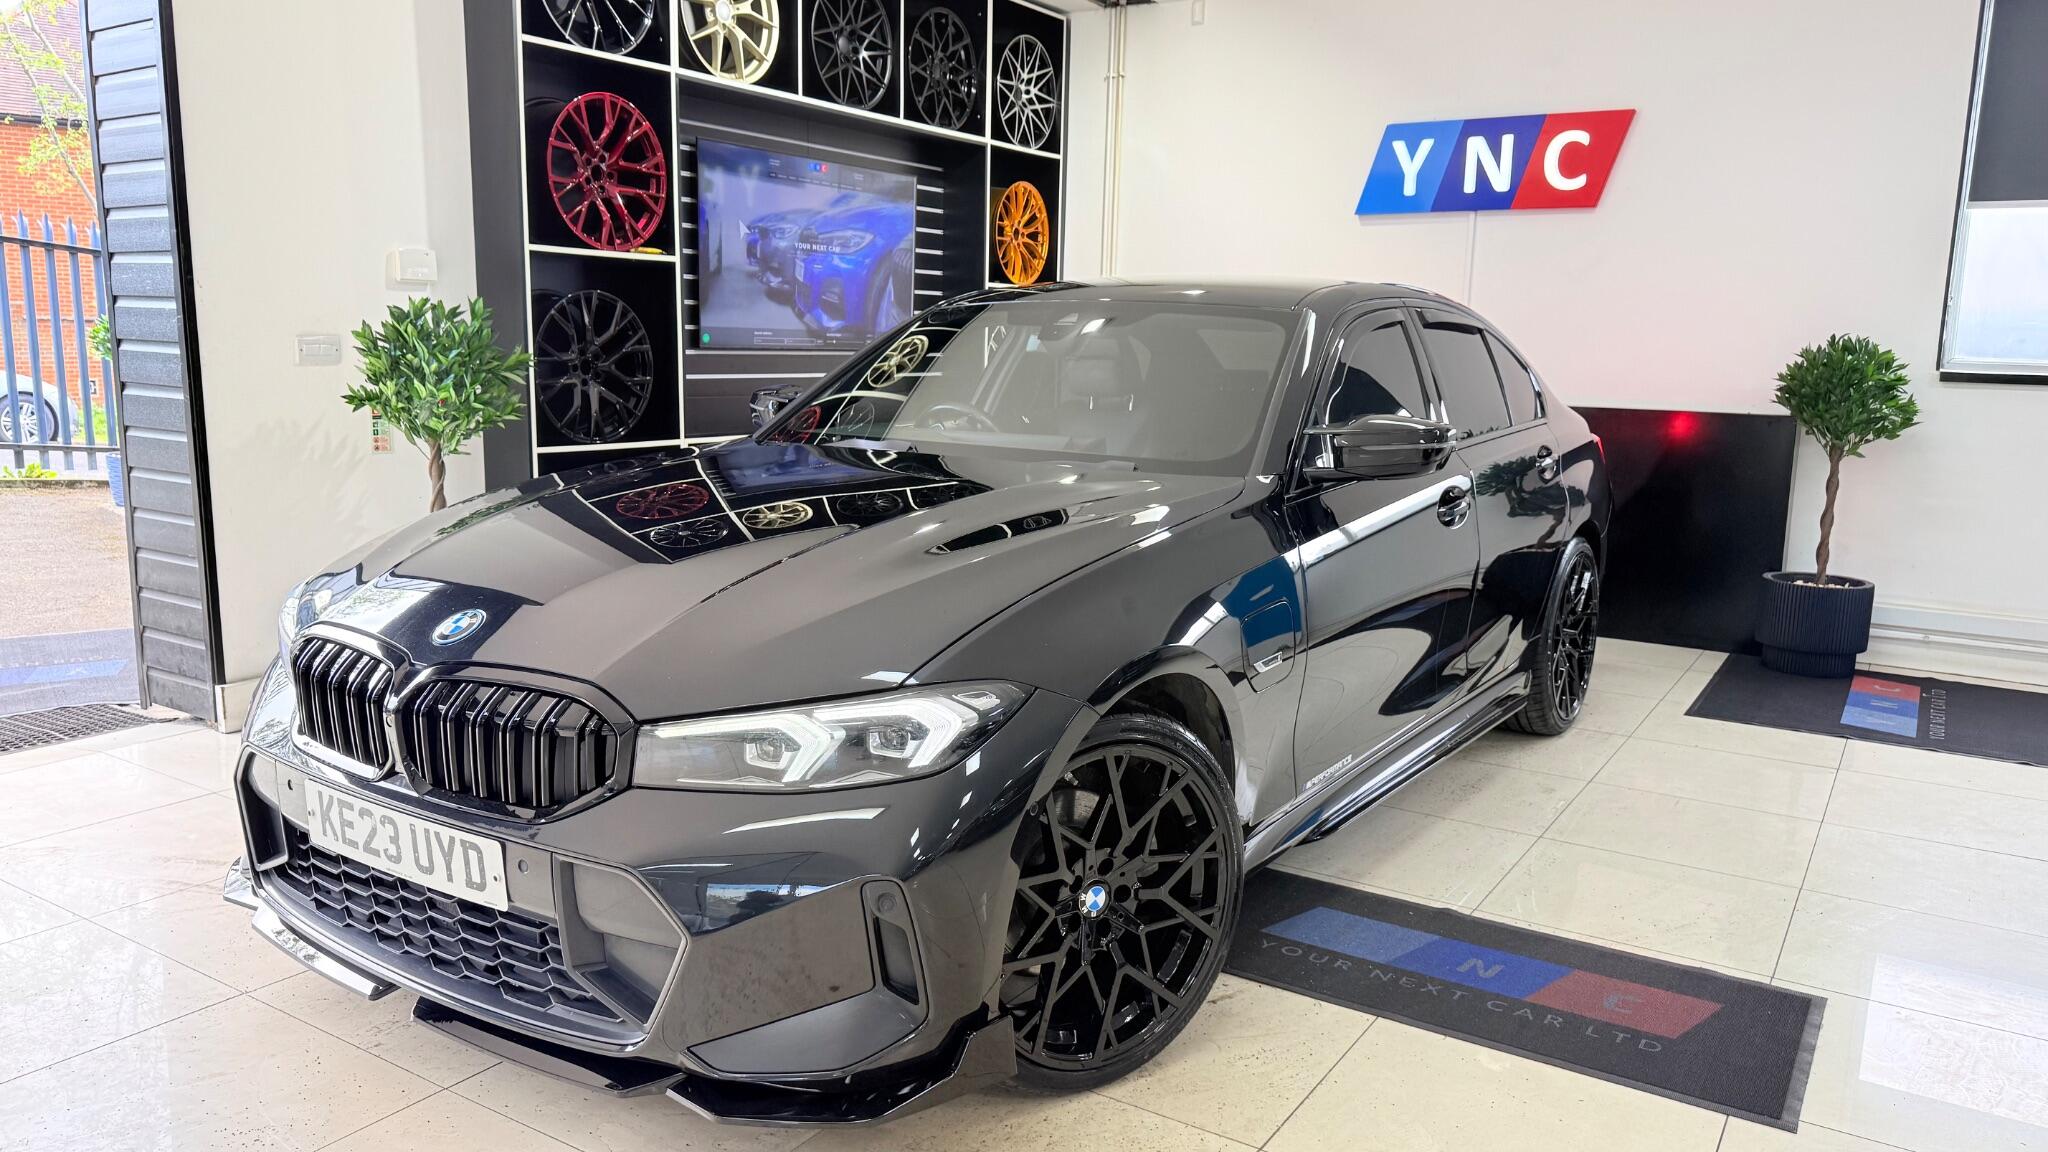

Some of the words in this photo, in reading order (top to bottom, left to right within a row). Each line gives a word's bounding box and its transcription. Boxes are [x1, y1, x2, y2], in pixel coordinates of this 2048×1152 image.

[1391, 129, 1591, 197] YNC
[794, 242, 811, 250] YOUR
[317, 790, 402, 865] KE23
[409, 823, 487, 892] UYD
[1261, 938, 1352, 971] YOUR
[1369, 969, 1470, 1001] NEXT
[1486, 1000, 1564, 1028] CAR
[1585, 1025, 1663, 1052] LTD
